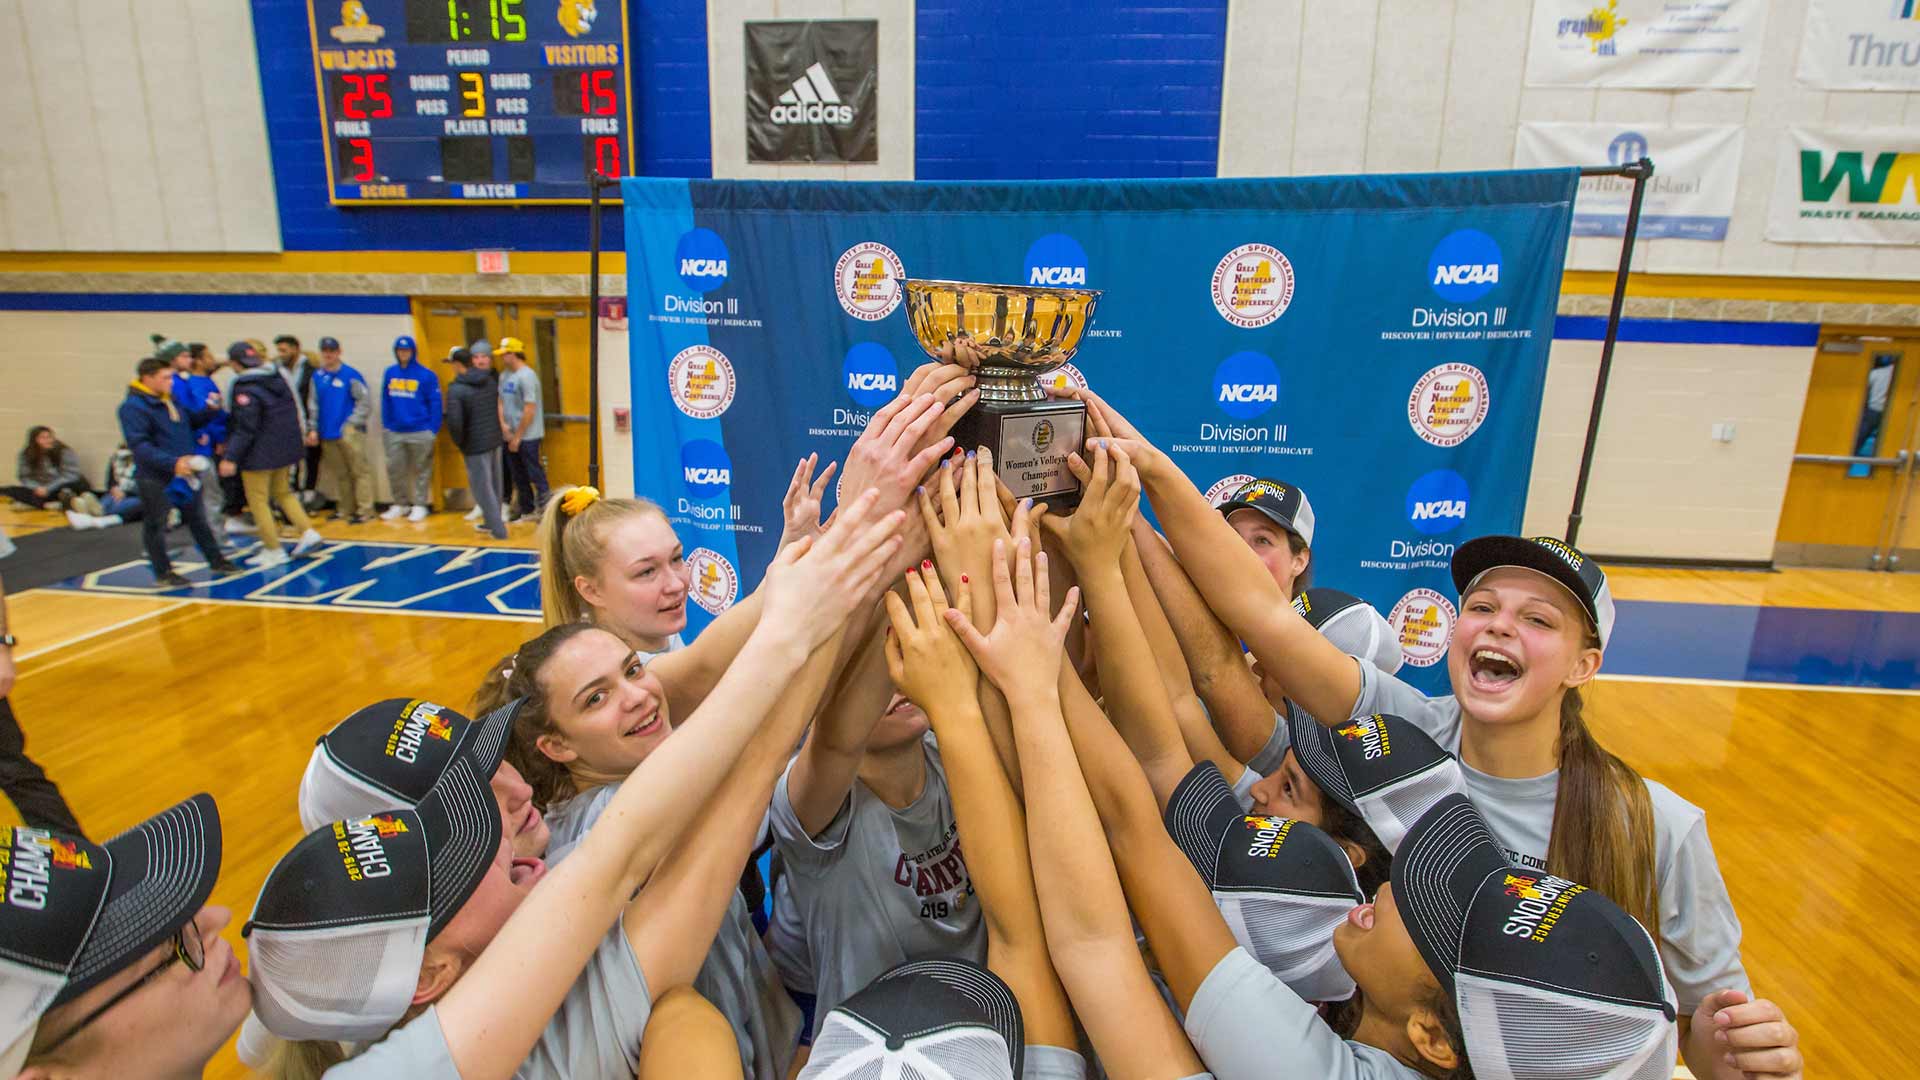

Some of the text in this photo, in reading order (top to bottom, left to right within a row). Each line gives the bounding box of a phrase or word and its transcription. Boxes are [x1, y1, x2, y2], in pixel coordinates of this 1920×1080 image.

[319, 49, 396, 70] WILDCATS
[446, 49, 491, 65] PERIOD
[544, 45, 619, 66] VISITORS
[409, 75, 449, 91] BONUS
[490, 73, 531, 90] BONUS
[341, 74, 393, 119] 25
[459, 72, 486, 117] 3
[580, 70, 617, 115] 15
[416, 99, 448, 115] POSS
[496, 97, 529, 114] POSS
[770, 99, 853, 125] adidas
[334, 120, 370, 137] FOULS
[444, 118, 527, 135] PLAYER FOULS
[581, 117, 619, 133] FOULS
[350, 139, 375, 181] 3
[595, 137, 620, 178] 0
[360, 184, 407, 198] SCORE
[462, 184, 516, 198] MATCH
[680, 258, 728, 277] NCAA
[1030, 267, 1086, 285] NCAA
[1434, 264, 1499, 285] NCAA
[664, 294, 738, 315] Division III
[724, 318, 762, 327] DEDICATE
[1225, 312, 1278, 328] INTEGRITY
[1412, 307, 1507, 327] Division III
[1381, 330, 1430, 340] DISCOVER
[1434, 330, 1482, 340] DEVELOP
[848, 372, 897, 391] NCAA
[1219, 384, 1278, 402] NCAA
[833, 408, 871, 427] Divisi
[808, 428, 849, 437] DISCOVER
[1200, 423, 1287, 442] Division III
[1172, 444, 1314, 456] DISCOVER DEVELOP DEDICATE
[1005, 457, 1039, 470] Women's
[684, 466, 731, 485] NCAA
[1021, 468, 1059, 481] Champion
[1031, 482, 1048, 493] 2019
[1411, 500, 1467, 520] NCAA
[1391, 539, 1455, 558] Division
[1361, 559, 1449, 570] DISCOVER DEVELOP
[1403, 654, 1441, 666] TEGRITY
